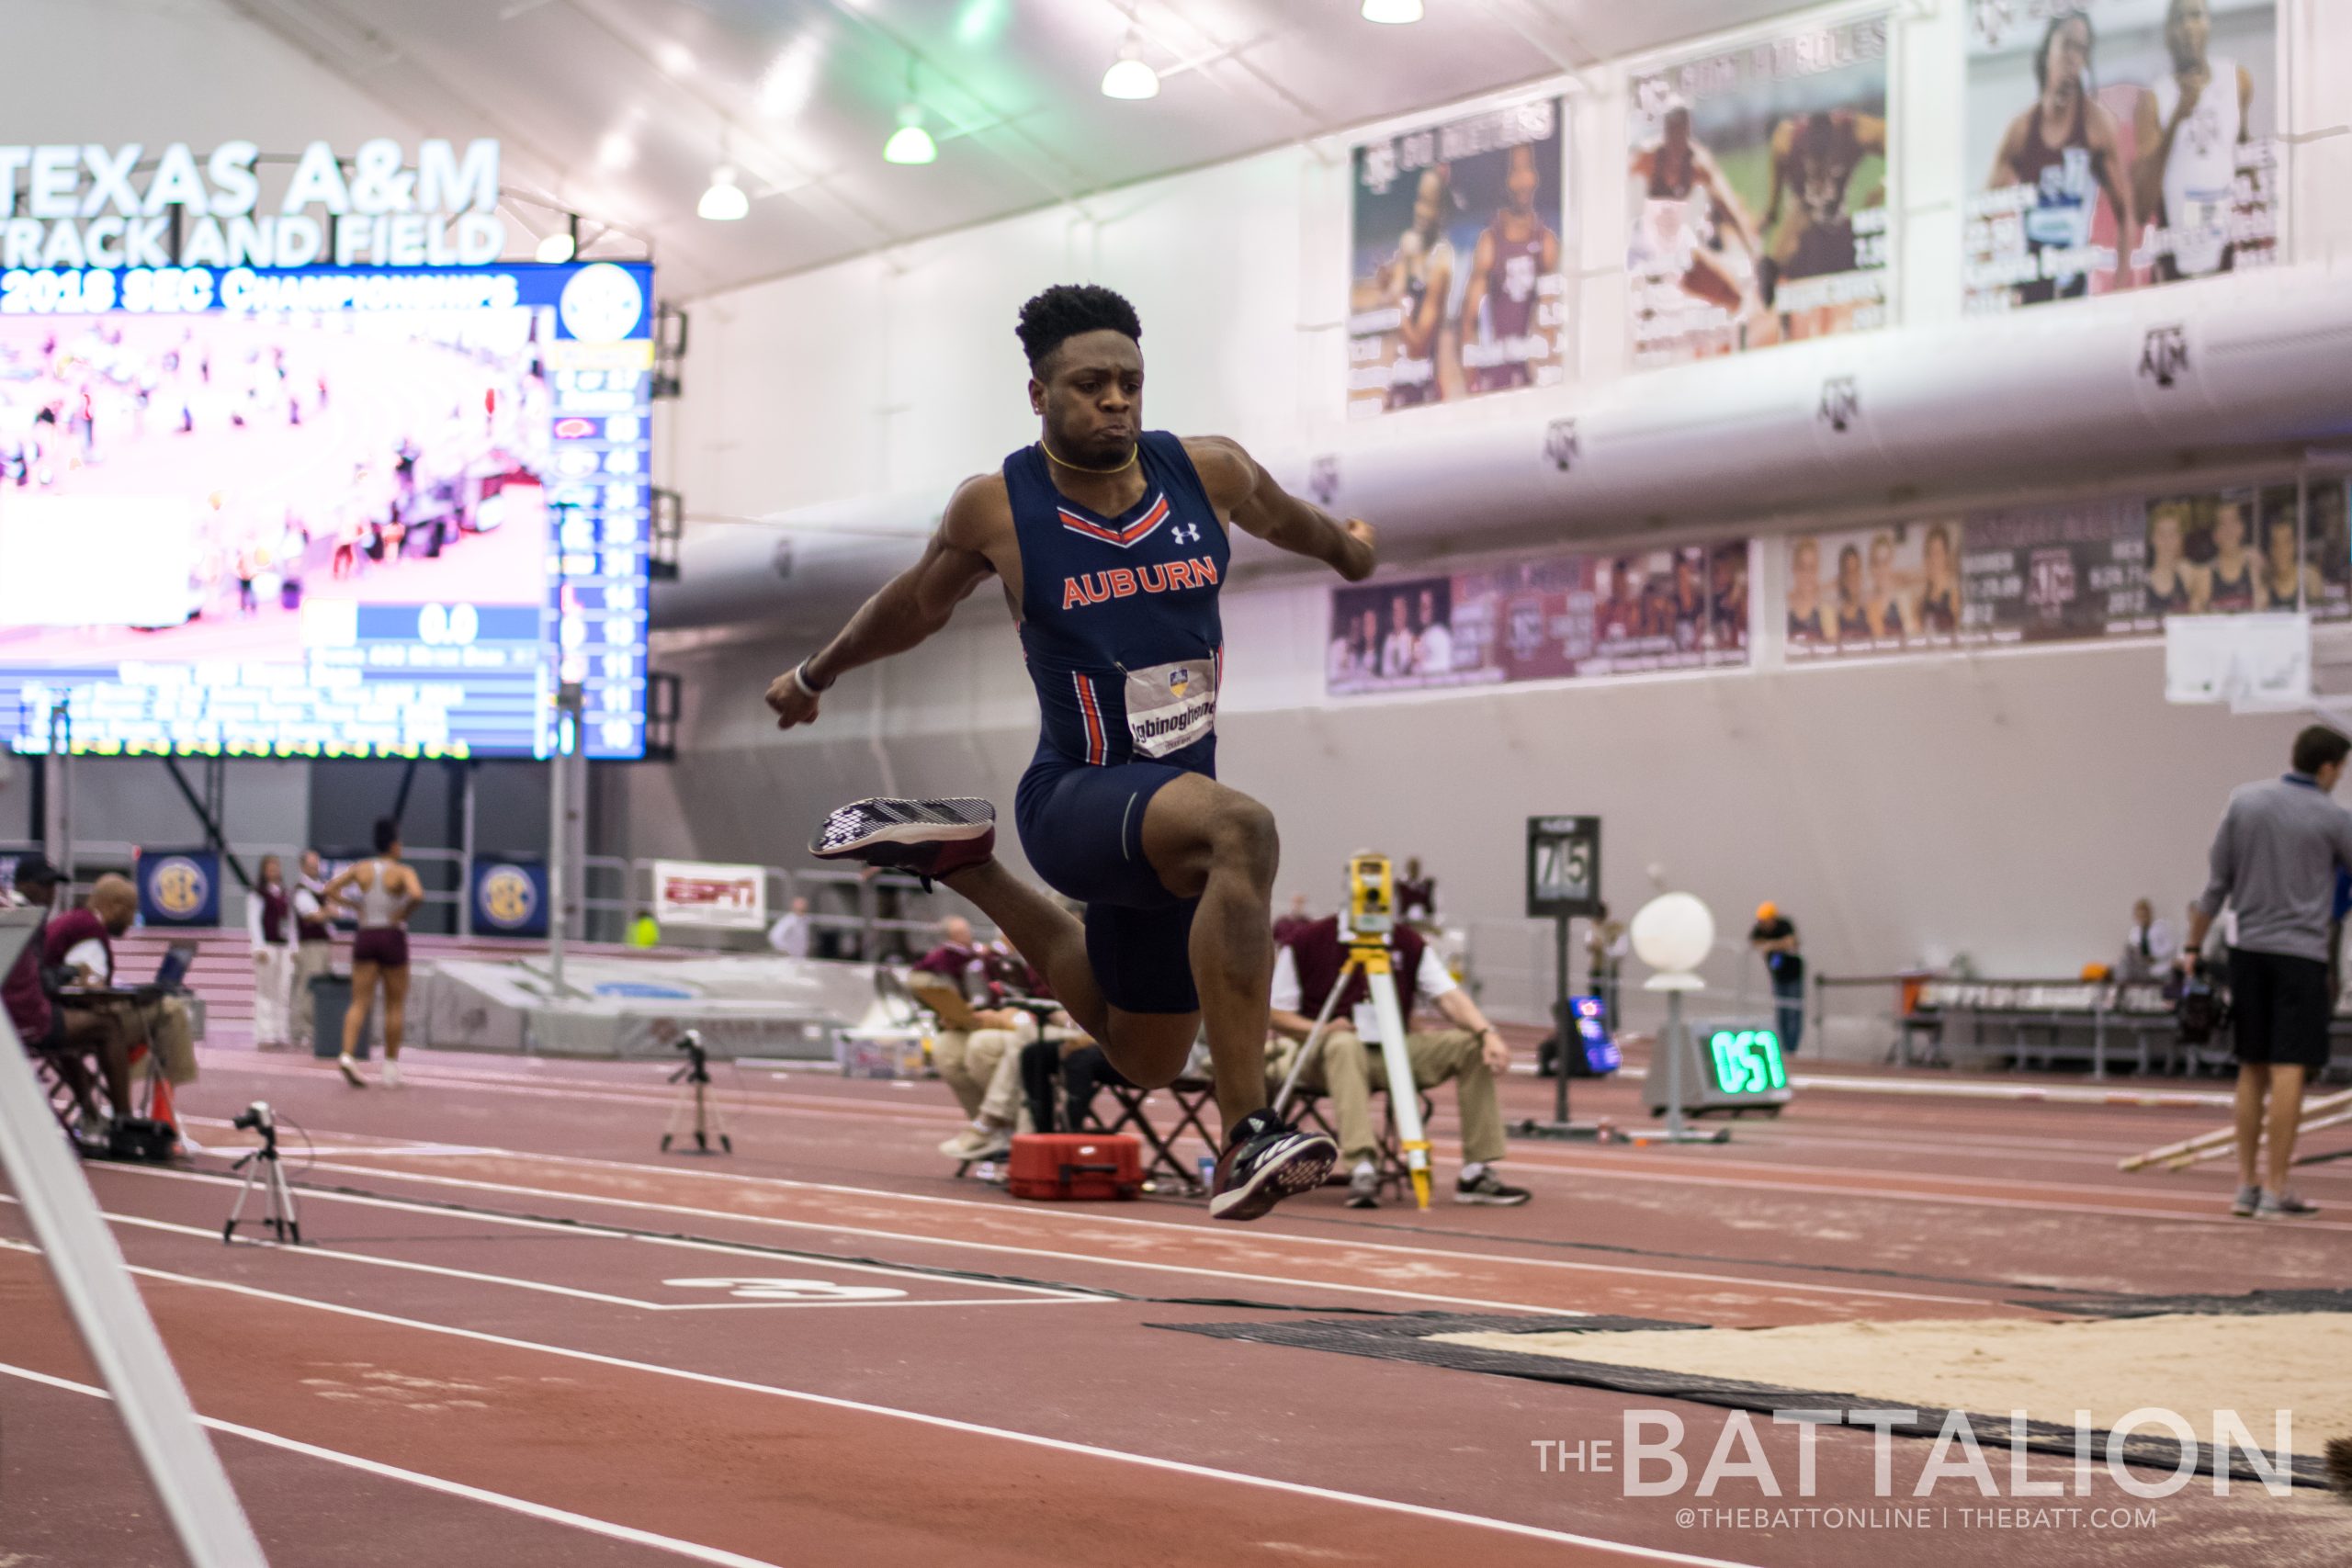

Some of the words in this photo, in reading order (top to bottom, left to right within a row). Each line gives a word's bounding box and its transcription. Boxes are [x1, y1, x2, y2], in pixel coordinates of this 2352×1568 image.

[0, 141, 260, 220] TEXAS
[282, 137, 501, 218] A&M
[0, 216, 172, 268] RACK
[181, 215, 322, 268] AND
[334, 212, 506, 267] FIELD
[121, 267, 214, 312] SEC
[1062, 556, 1218, 610] AUBURN
[664, 875, 756, 908] ESPN
